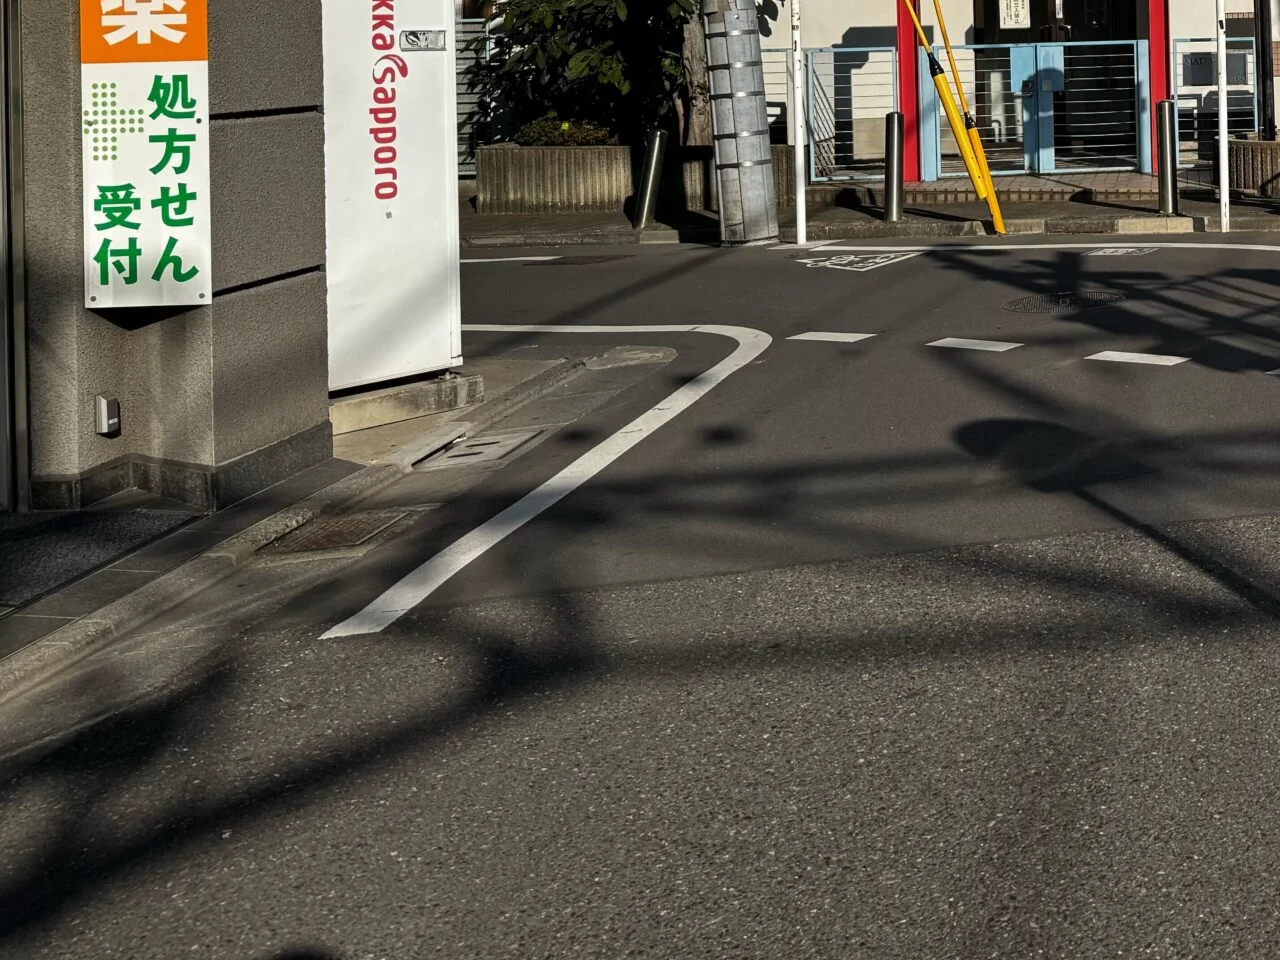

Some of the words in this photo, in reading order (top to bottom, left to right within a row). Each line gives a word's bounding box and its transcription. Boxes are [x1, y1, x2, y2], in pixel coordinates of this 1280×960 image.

[147, 74, 200, 285] 処方せん
[369, 64, 399, 200] sapporo
[93, 184, 142, 286] 受付
